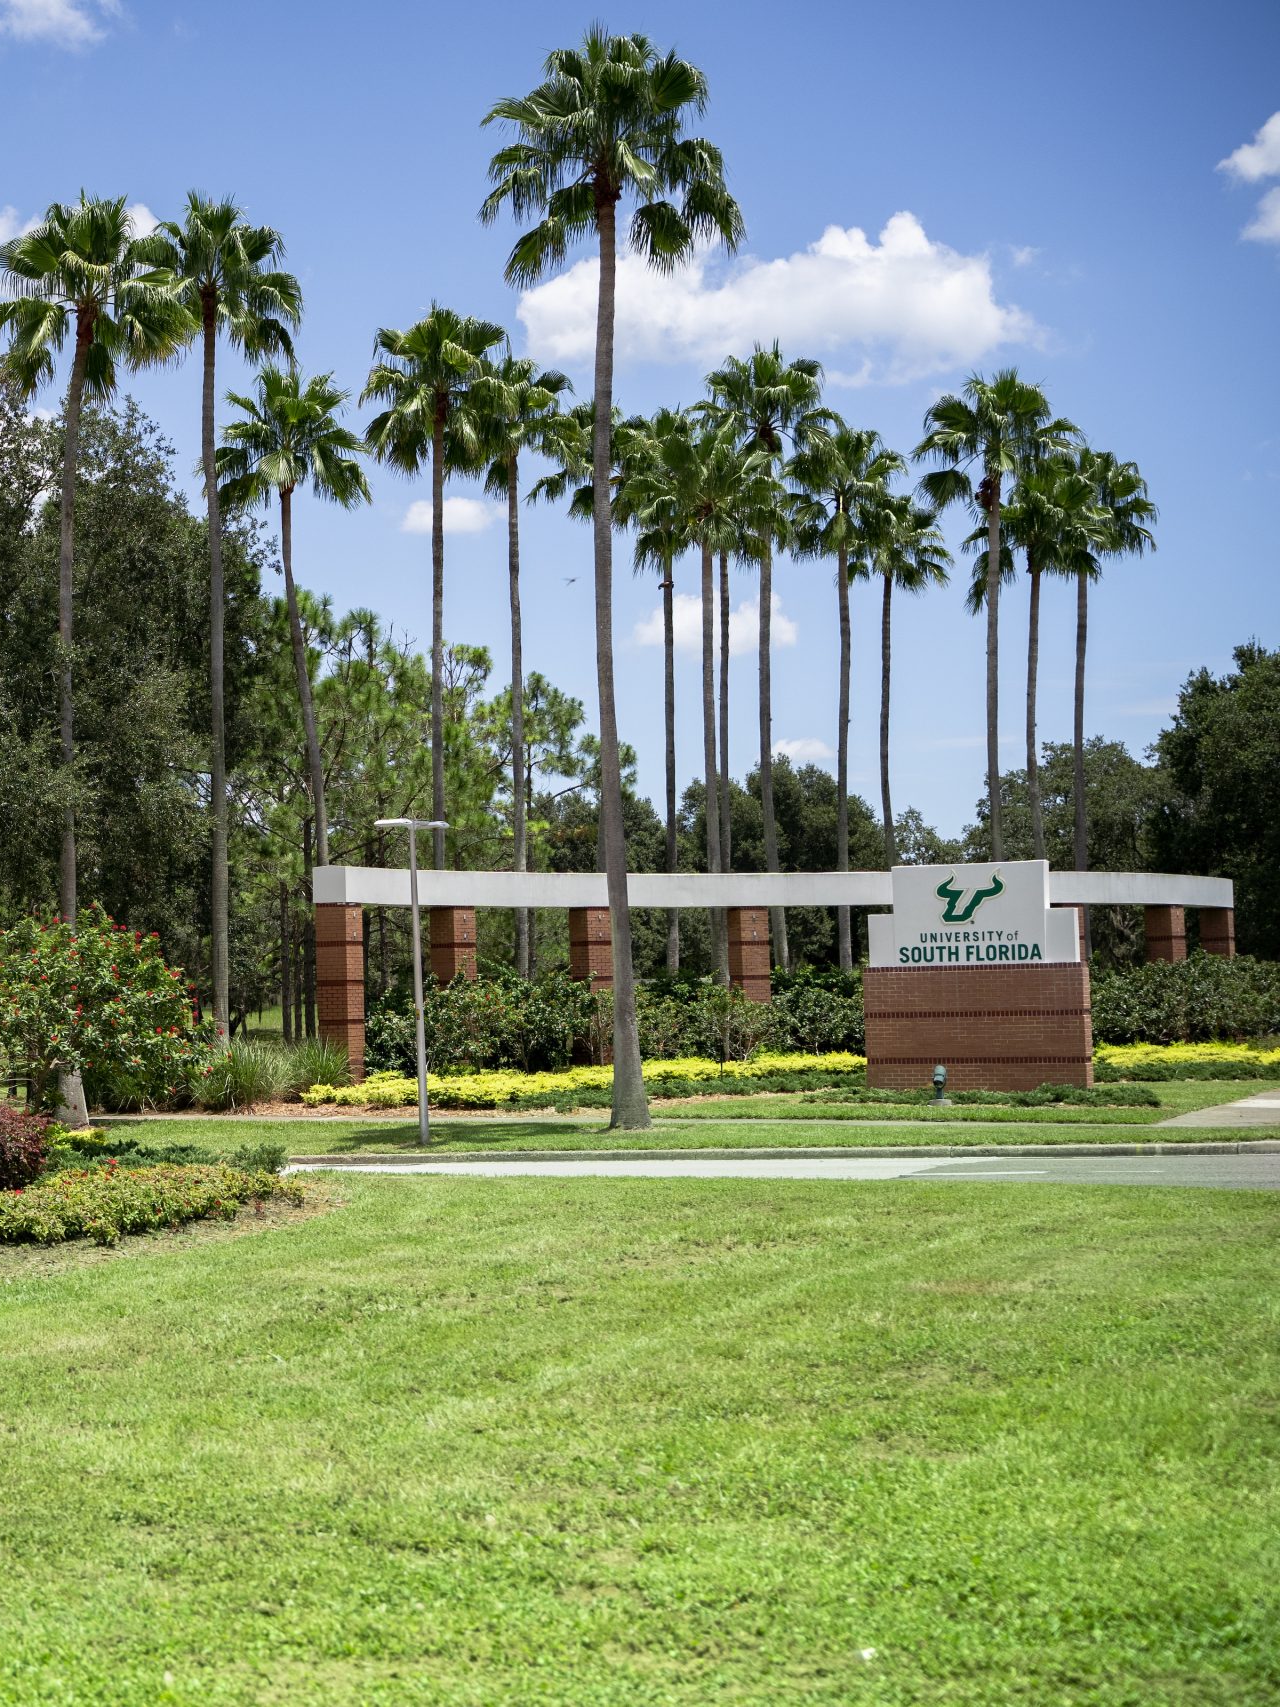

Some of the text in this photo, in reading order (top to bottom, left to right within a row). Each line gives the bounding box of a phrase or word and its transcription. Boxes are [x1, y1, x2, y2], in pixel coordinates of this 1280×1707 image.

[920, 930, 1020, 943] UNIVERSITY of
[899, 943, 1042, 964] SOUTH FLORIDA
